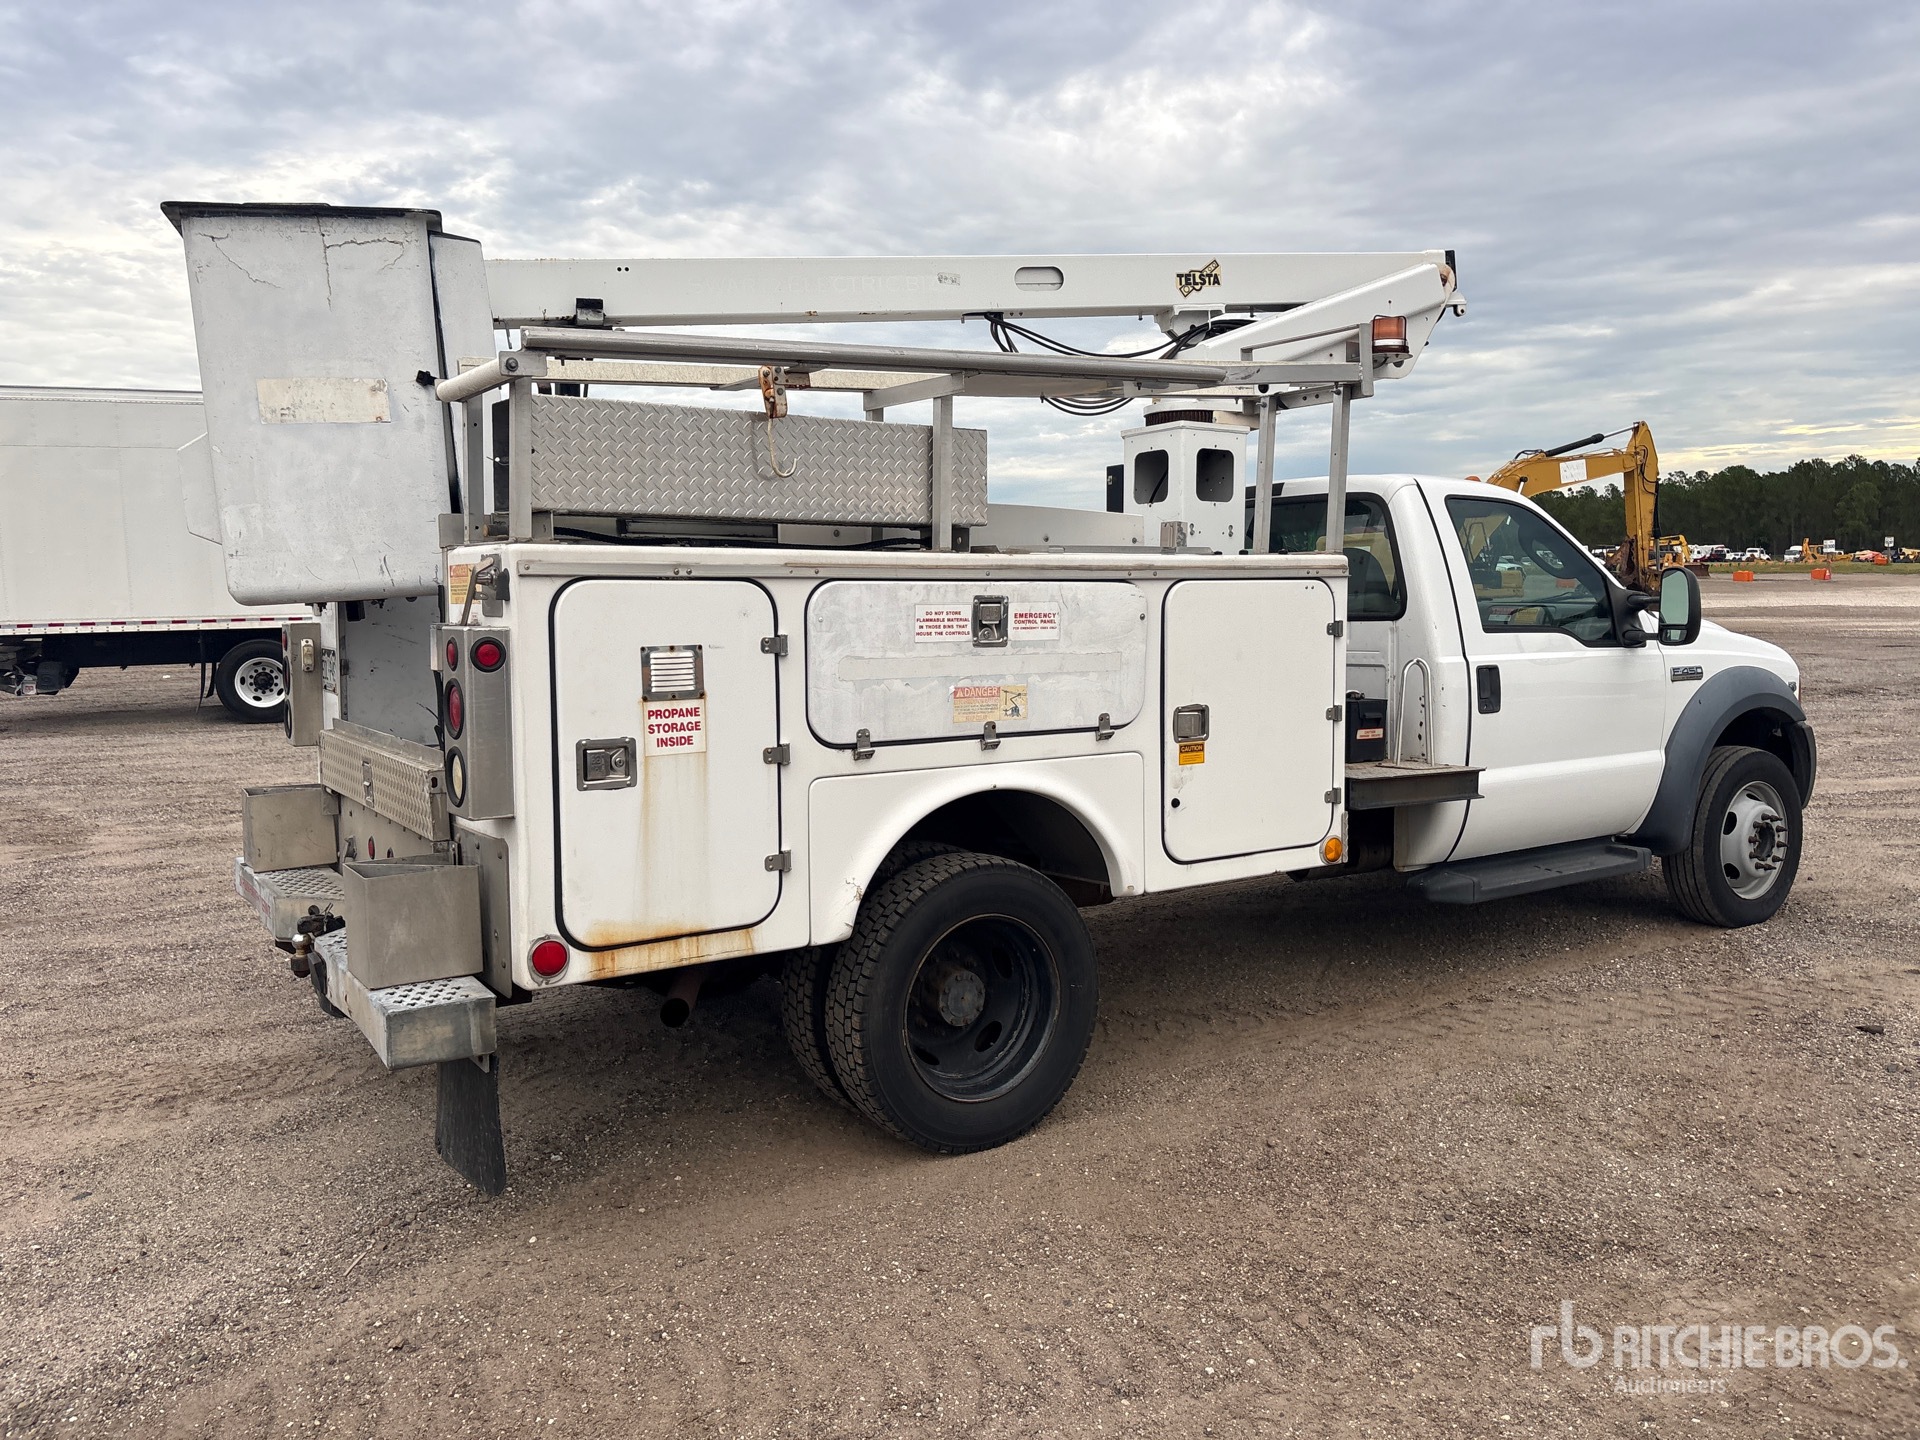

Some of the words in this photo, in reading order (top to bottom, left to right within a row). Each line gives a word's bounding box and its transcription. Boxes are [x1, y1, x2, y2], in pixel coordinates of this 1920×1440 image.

[1176, 273, 1221, 286] TELSTA
[964, 687, 998, 697] DANGER
[647, 707, 700, 720] PROPANE
[647, 721, 701, 734] STORAGE
[656, 735, 694, 748] INSIDE
